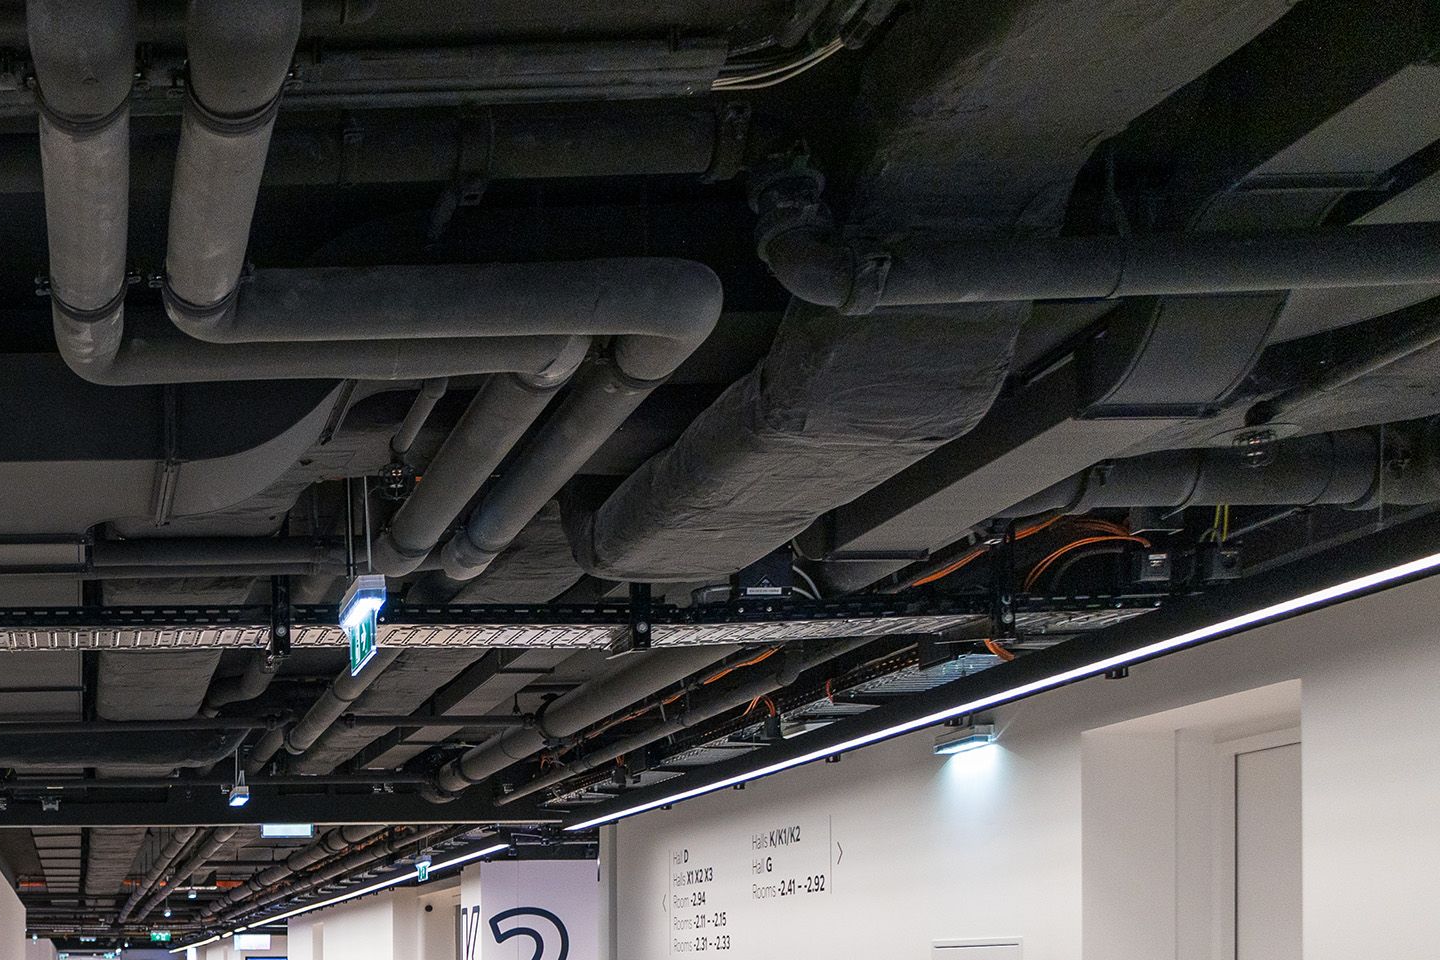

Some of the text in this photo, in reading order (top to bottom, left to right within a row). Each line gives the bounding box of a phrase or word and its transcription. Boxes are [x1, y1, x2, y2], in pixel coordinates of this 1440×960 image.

[752, 826, 801, 850] Halls K/K1/K2
[673, 849, 689, 864] Hall D
[752, 856, 773, 875] Hall G
[673, 867, 713, 887] Halls X1 X2 X3
[752, 883, 777, 899] Rooms
[778, 879, 796, 896] -2.41
[804, 874, 825, 893] -2.92
[673, 892, 706, 908] Room -2.94
[673, 917, 693, 930] Rooms
[673, 938, 693, 952] Rooms
[693, 937, 707, 951] -2.31
[714, 935, 731, 950] -2.33
